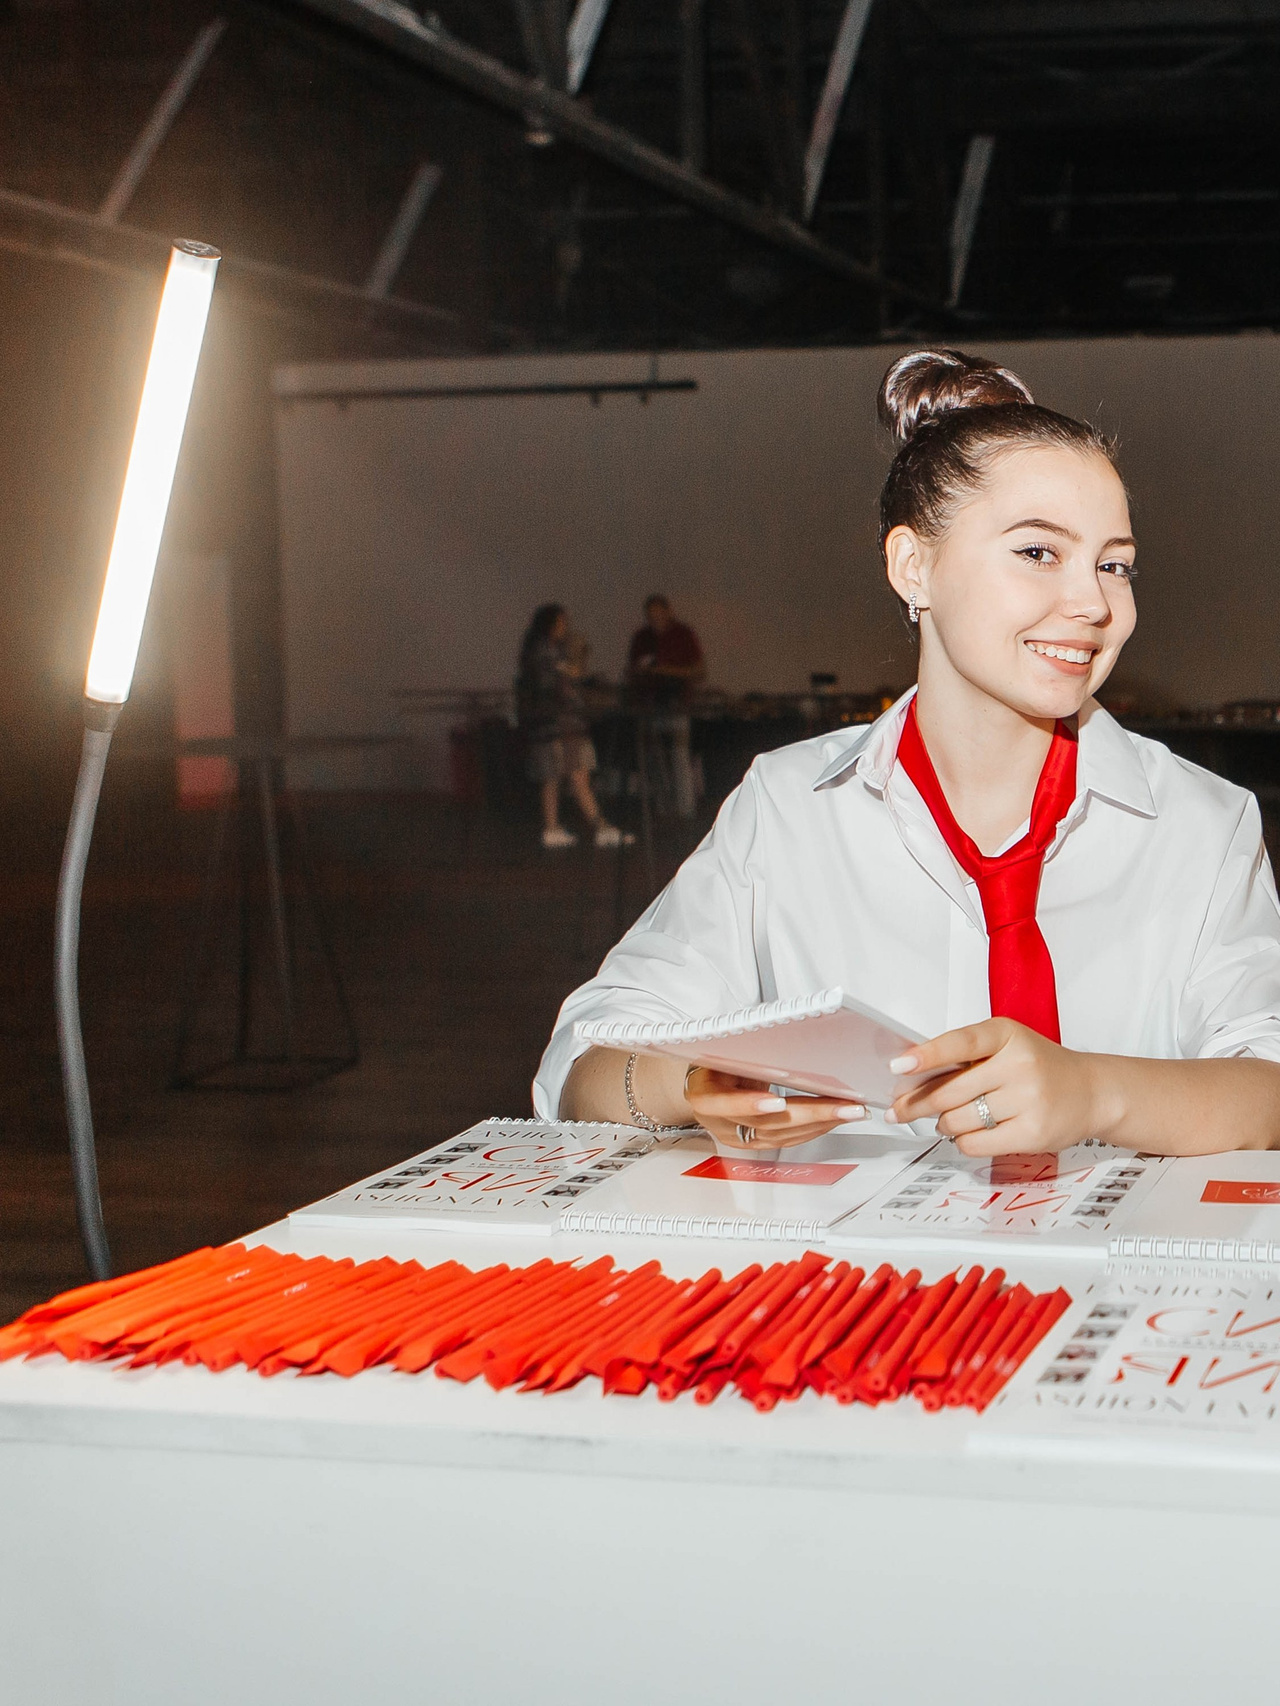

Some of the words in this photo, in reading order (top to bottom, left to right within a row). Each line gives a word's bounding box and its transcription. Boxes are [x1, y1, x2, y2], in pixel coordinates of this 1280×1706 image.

[459, 1130, 584, 1140] FASHION
[482, 1145, 607, 1164] СИ
[973, 1163, 1096, 1183] СИ
[326, 1193, 461, 1204] FASHION
